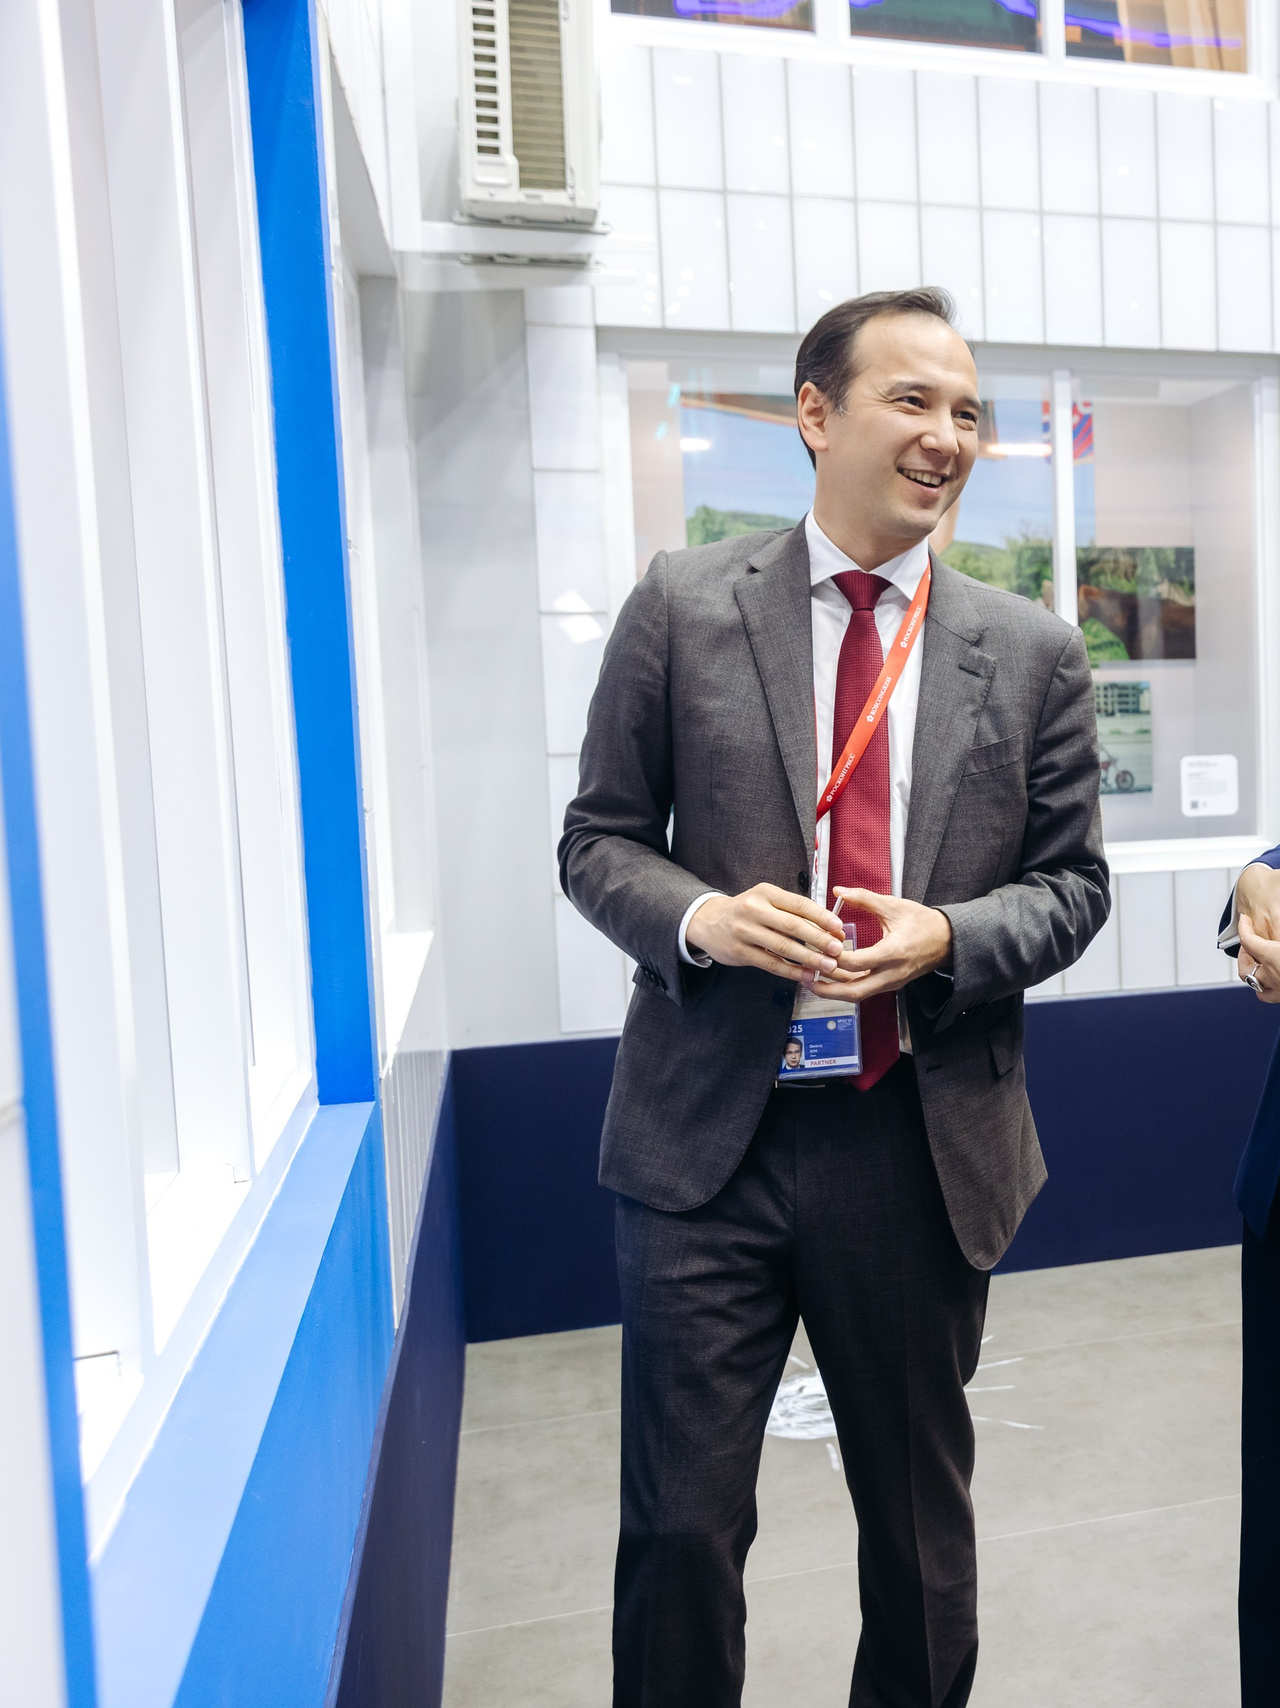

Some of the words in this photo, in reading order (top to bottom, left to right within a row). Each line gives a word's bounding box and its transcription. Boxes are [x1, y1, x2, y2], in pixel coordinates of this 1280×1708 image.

[870, 675, 892, 716] ROSCONGRESS
[830, 752, 856, 795] РОСКОНГРЕСС
[788, 1024, 803, 1034] 25
[810, 1058, 837, 1066] PARTNER
